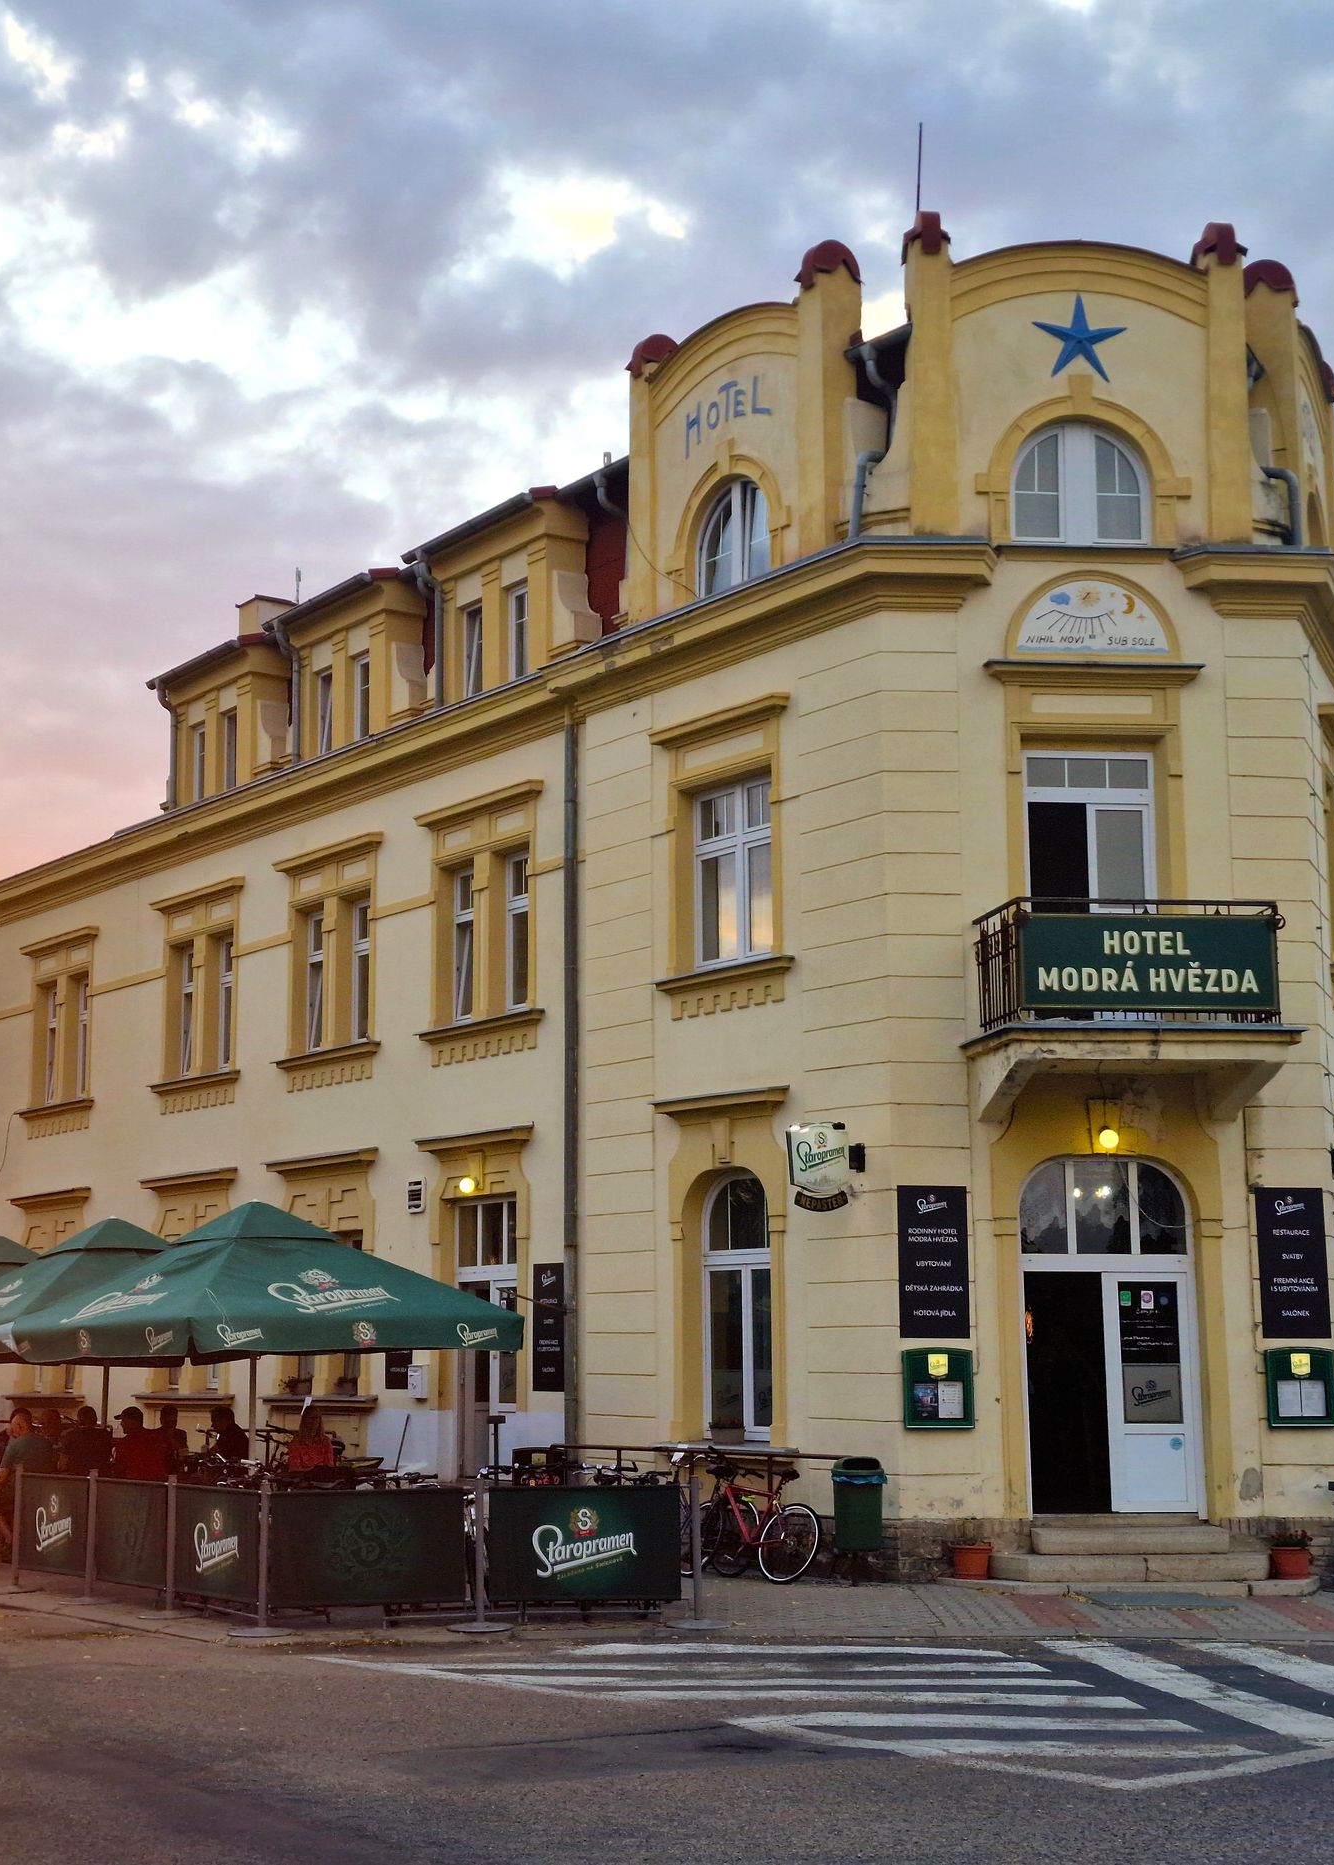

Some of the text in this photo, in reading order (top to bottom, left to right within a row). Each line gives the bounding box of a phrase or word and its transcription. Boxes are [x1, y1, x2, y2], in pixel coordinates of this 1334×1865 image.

[685, 375, 773, 459] HOTEL
[1026, 634, 1054, 643] NIHIL
[1059, 635, 1084, 643] NOVI
[1107, 636, 1128, 646] SUB
[1131, 637, 1155, 646] SOLE
[1103, 931, 1191, 955] HOTEL
[1038, 961, 1260, 994] MODRÁ HVĚZDA
[796, 1141, 847, 1172] Staropramen
[916, 1259, 952, 1267] UBYTOVÁNÍ
[267, 1282, 401, 1314] Staropramen
[929, 1284, 963, 1292] ZAHRÁDKA
[217, 1324, 264, 1347] Staropramen
[456, 1322, 499, 1347] Staropramen
[194, 1522, 239, 1573] Staropramen
[532, 1524, 638, 1578] Staropramen
